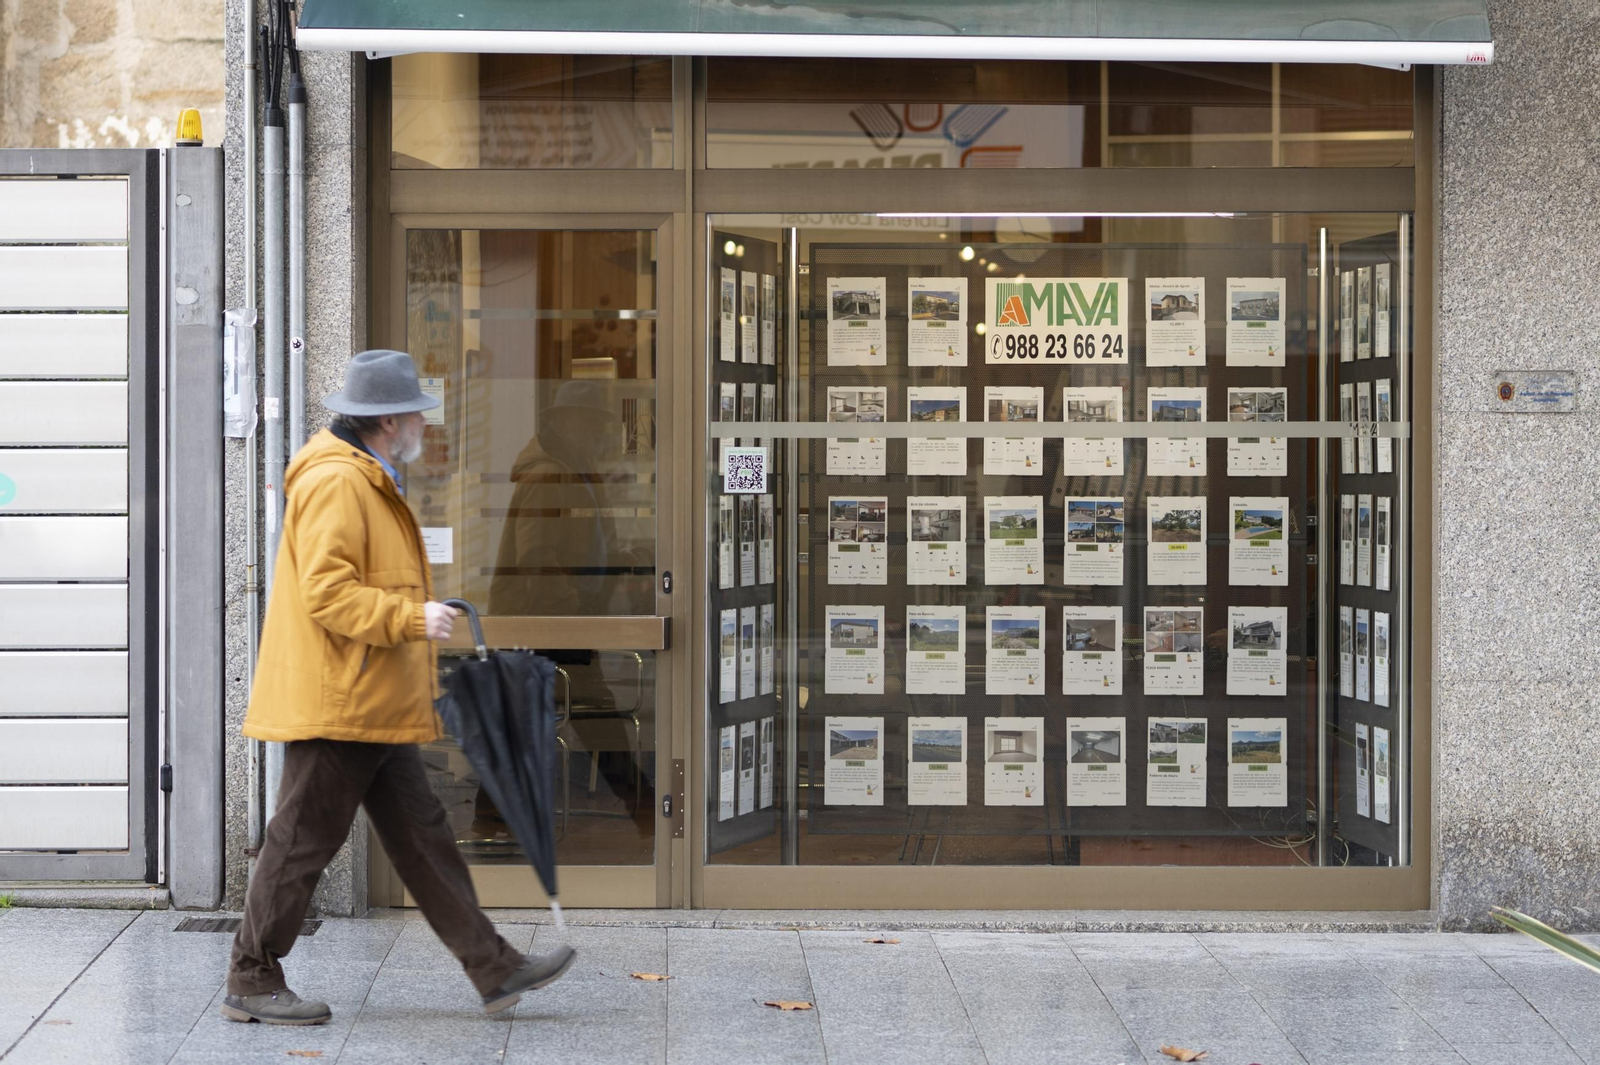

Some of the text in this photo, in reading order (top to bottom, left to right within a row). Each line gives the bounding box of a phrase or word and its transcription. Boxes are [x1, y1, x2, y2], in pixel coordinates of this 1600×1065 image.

[1005, 334, 1039, 359] 988
[1045, 334, 1067, 359] 23
[1074, 334, 1095, 359] 66
[1101, 334, 1123, 358] 24
